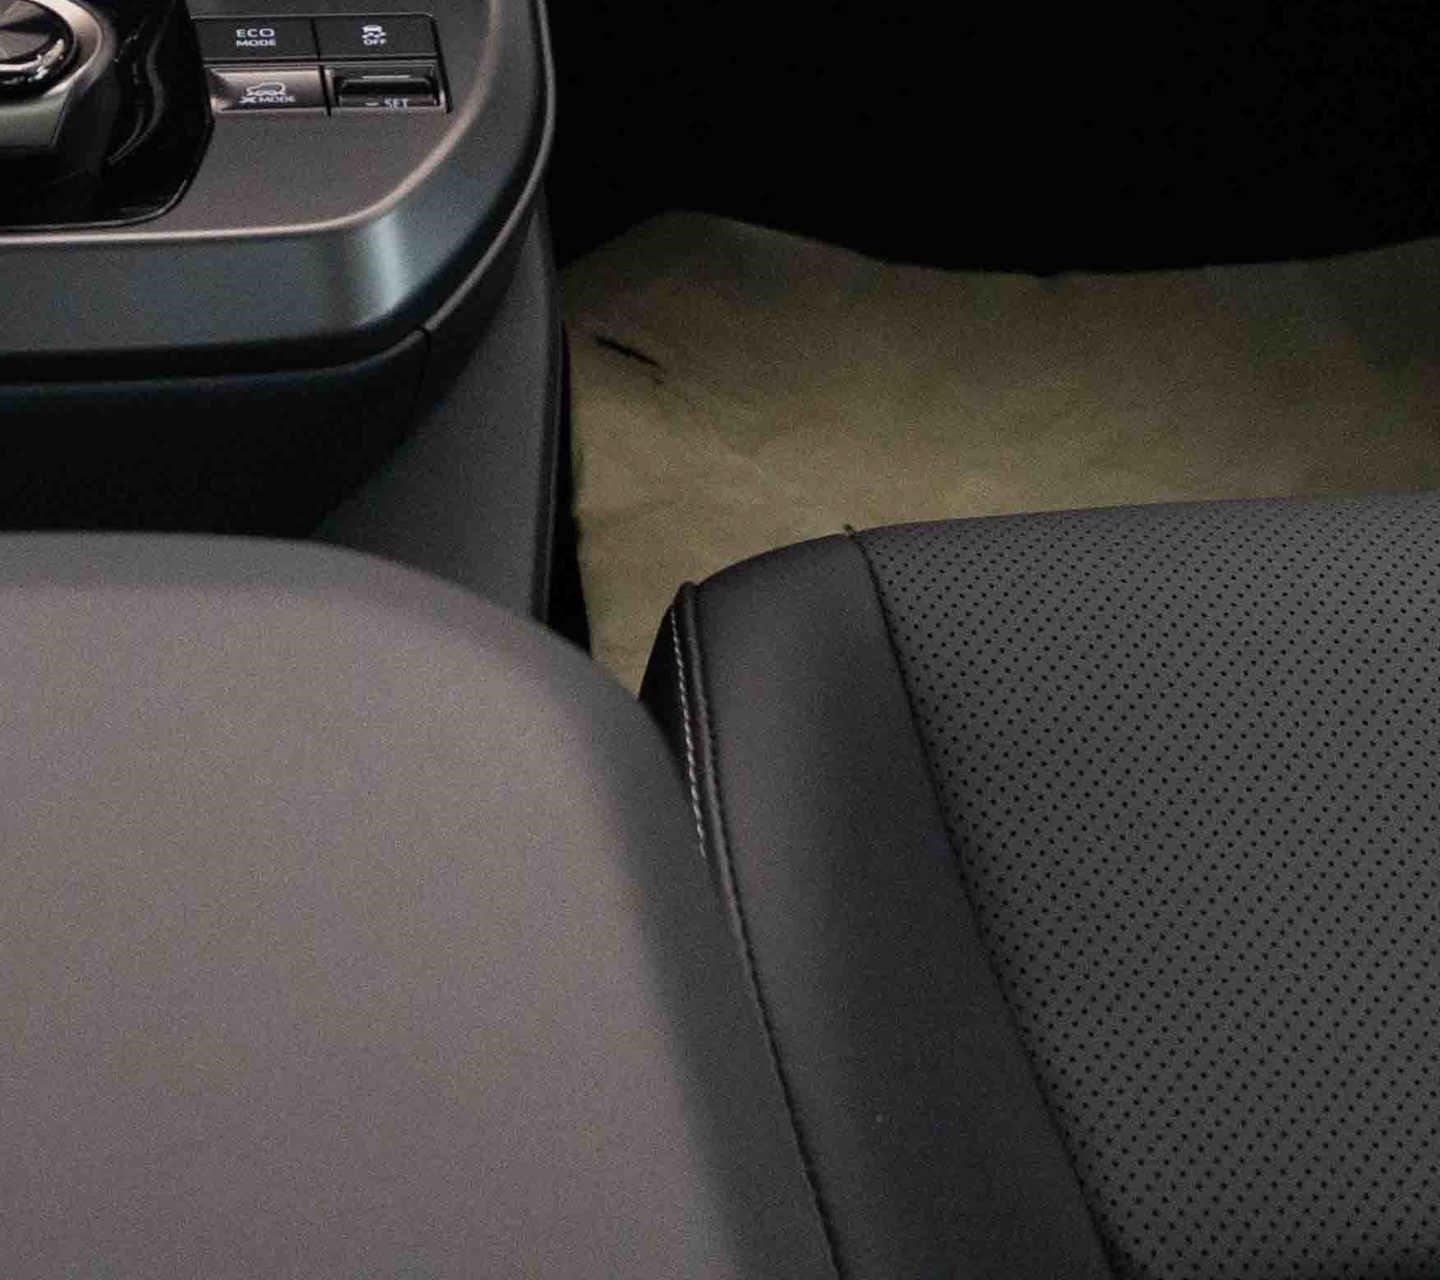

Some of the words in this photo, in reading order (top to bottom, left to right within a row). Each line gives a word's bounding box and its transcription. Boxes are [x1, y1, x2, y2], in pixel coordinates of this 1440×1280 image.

[236, 28, 276, 38] ECO
[236, 39, 277, 47] MODE
[363, 38, 387, 46] OFF
[383, 97, 410, 109] SET
